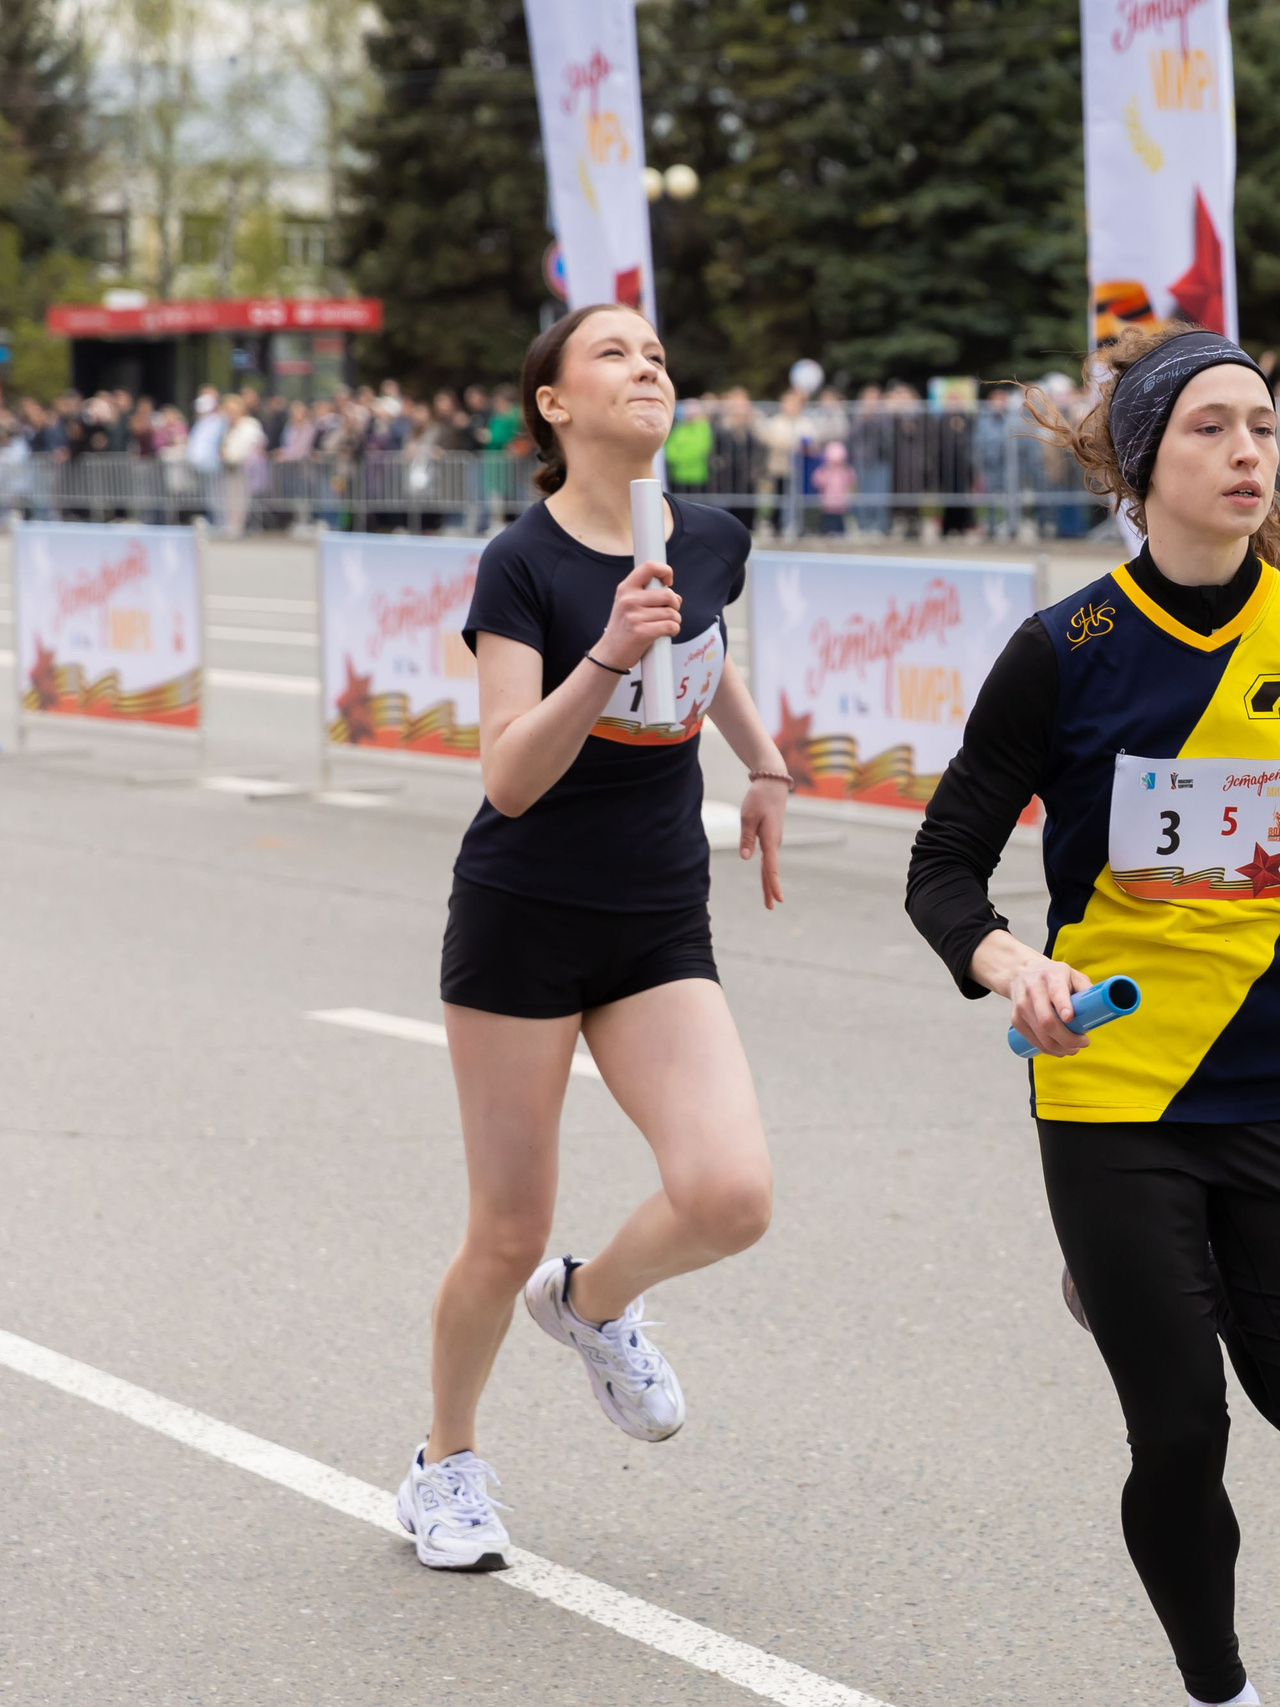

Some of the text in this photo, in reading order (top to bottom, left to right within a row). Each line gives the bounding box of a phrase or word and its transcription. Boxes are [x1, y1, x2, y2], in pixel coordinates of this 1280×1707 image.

[676, 676, 690, 700] 5
[1155, 806, 1238, 856] 3 5
